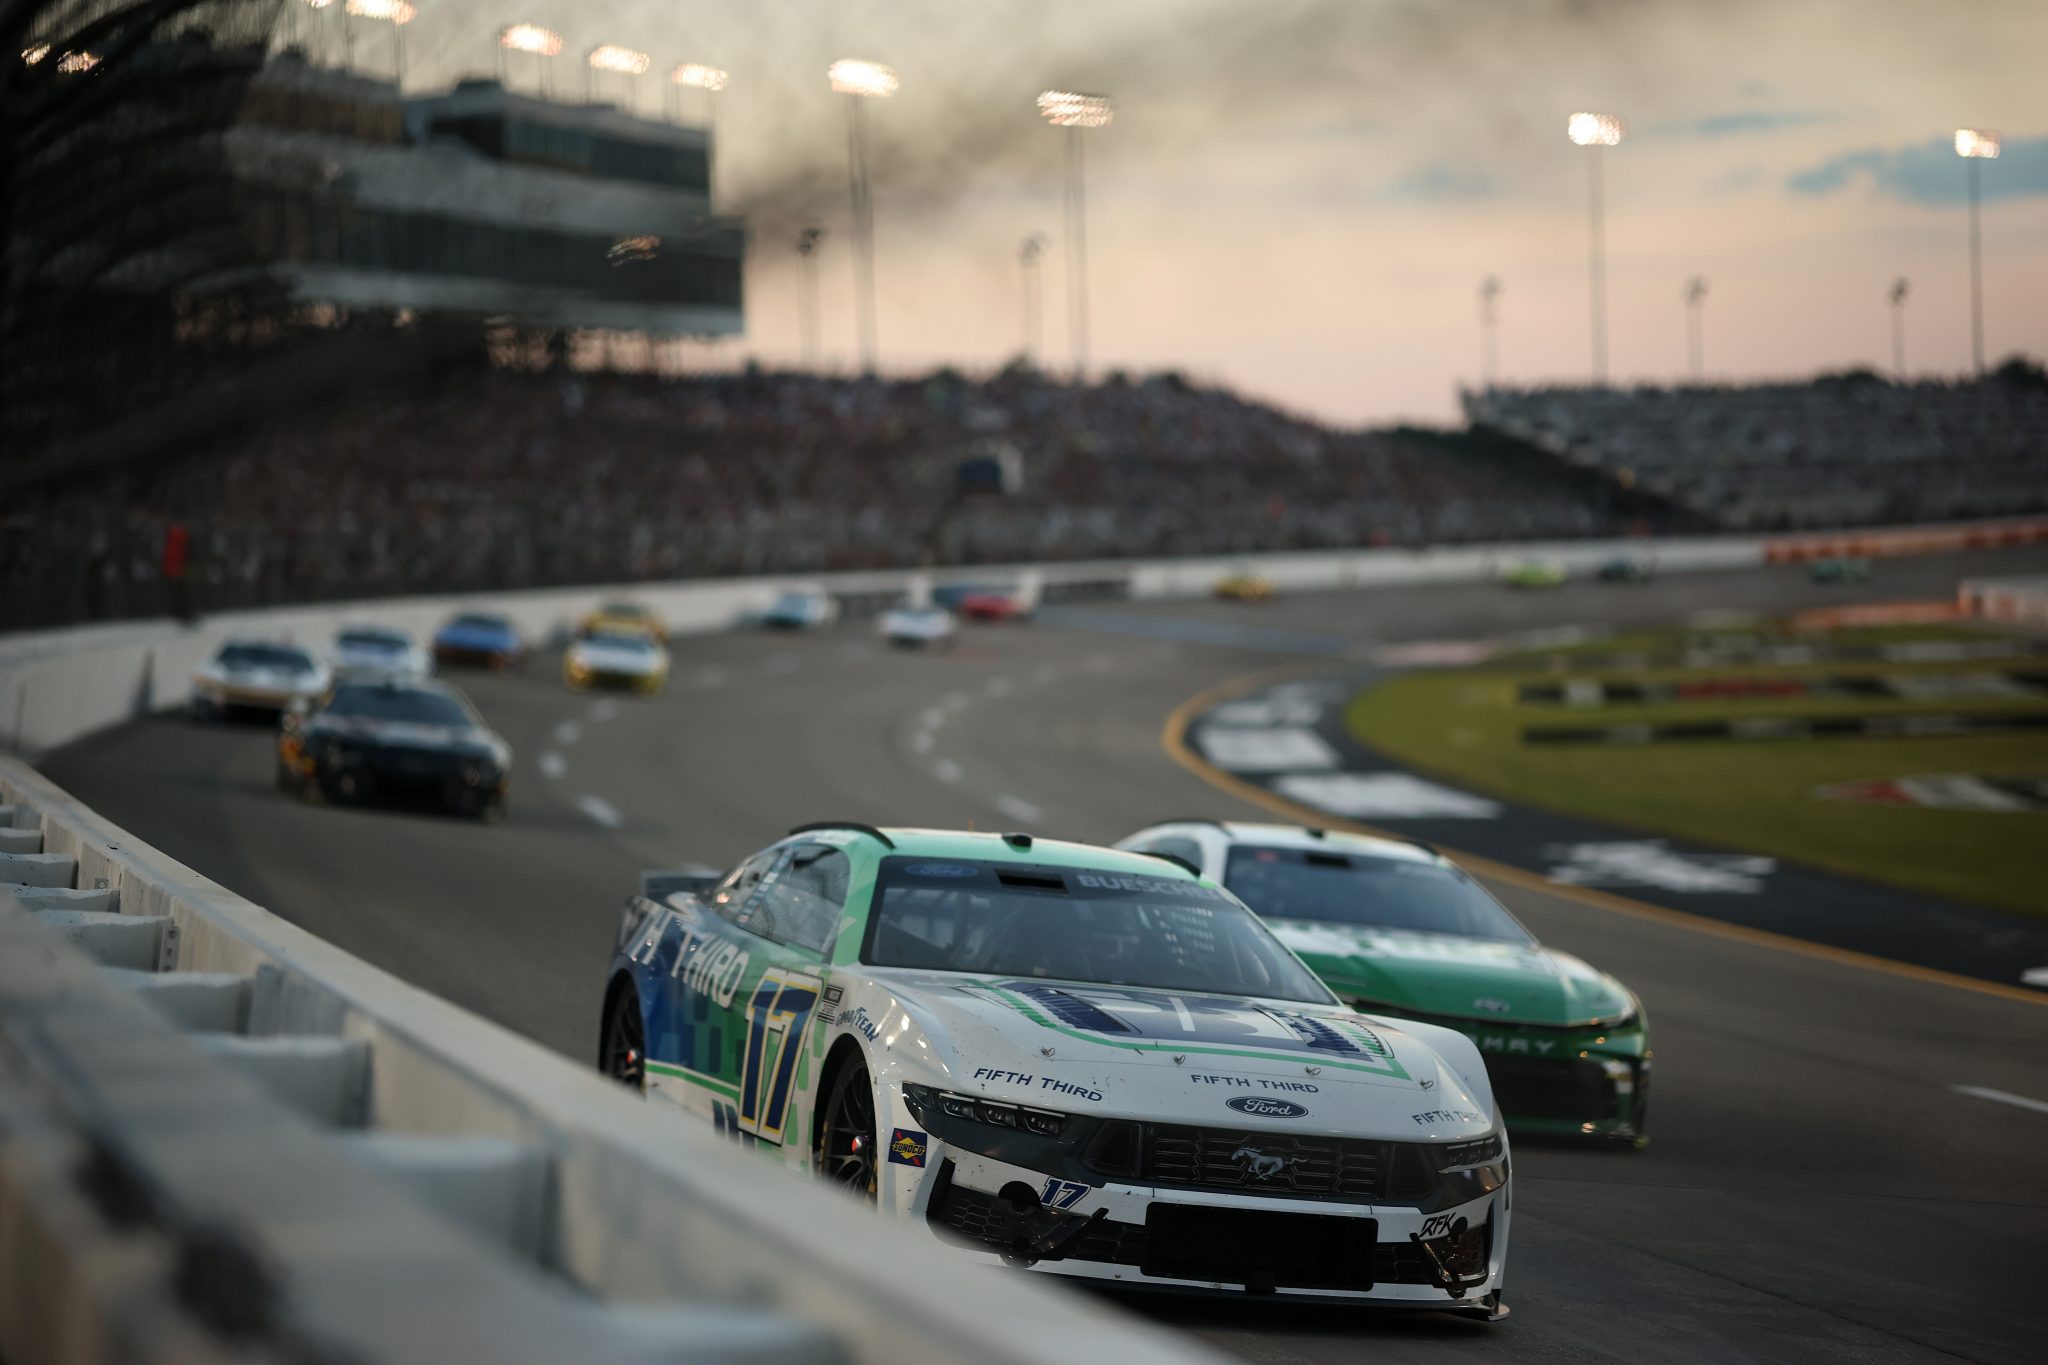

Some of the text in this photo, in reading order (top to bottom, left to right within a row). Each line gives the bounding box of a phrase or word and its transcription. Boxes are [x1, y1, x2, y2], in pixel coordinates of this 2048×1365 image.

[671, 924, 750, 1009] THIRD
[737, 965, 824, 1147] 17
[973, 1067, 1103, 1102] FIFTH THIRD
[1190, 1074, 1319, 1094] FIFTH THIRD
[1243, 1099, 1292, 1116] Ford
[1411, 1110, 1455, 1125] FIFTH
[892, 1142, 926, 1156] SUNOCO
[1040, 1176, 1091, 1210] 17
[1419, 1212, 1457, 1237] RFK
